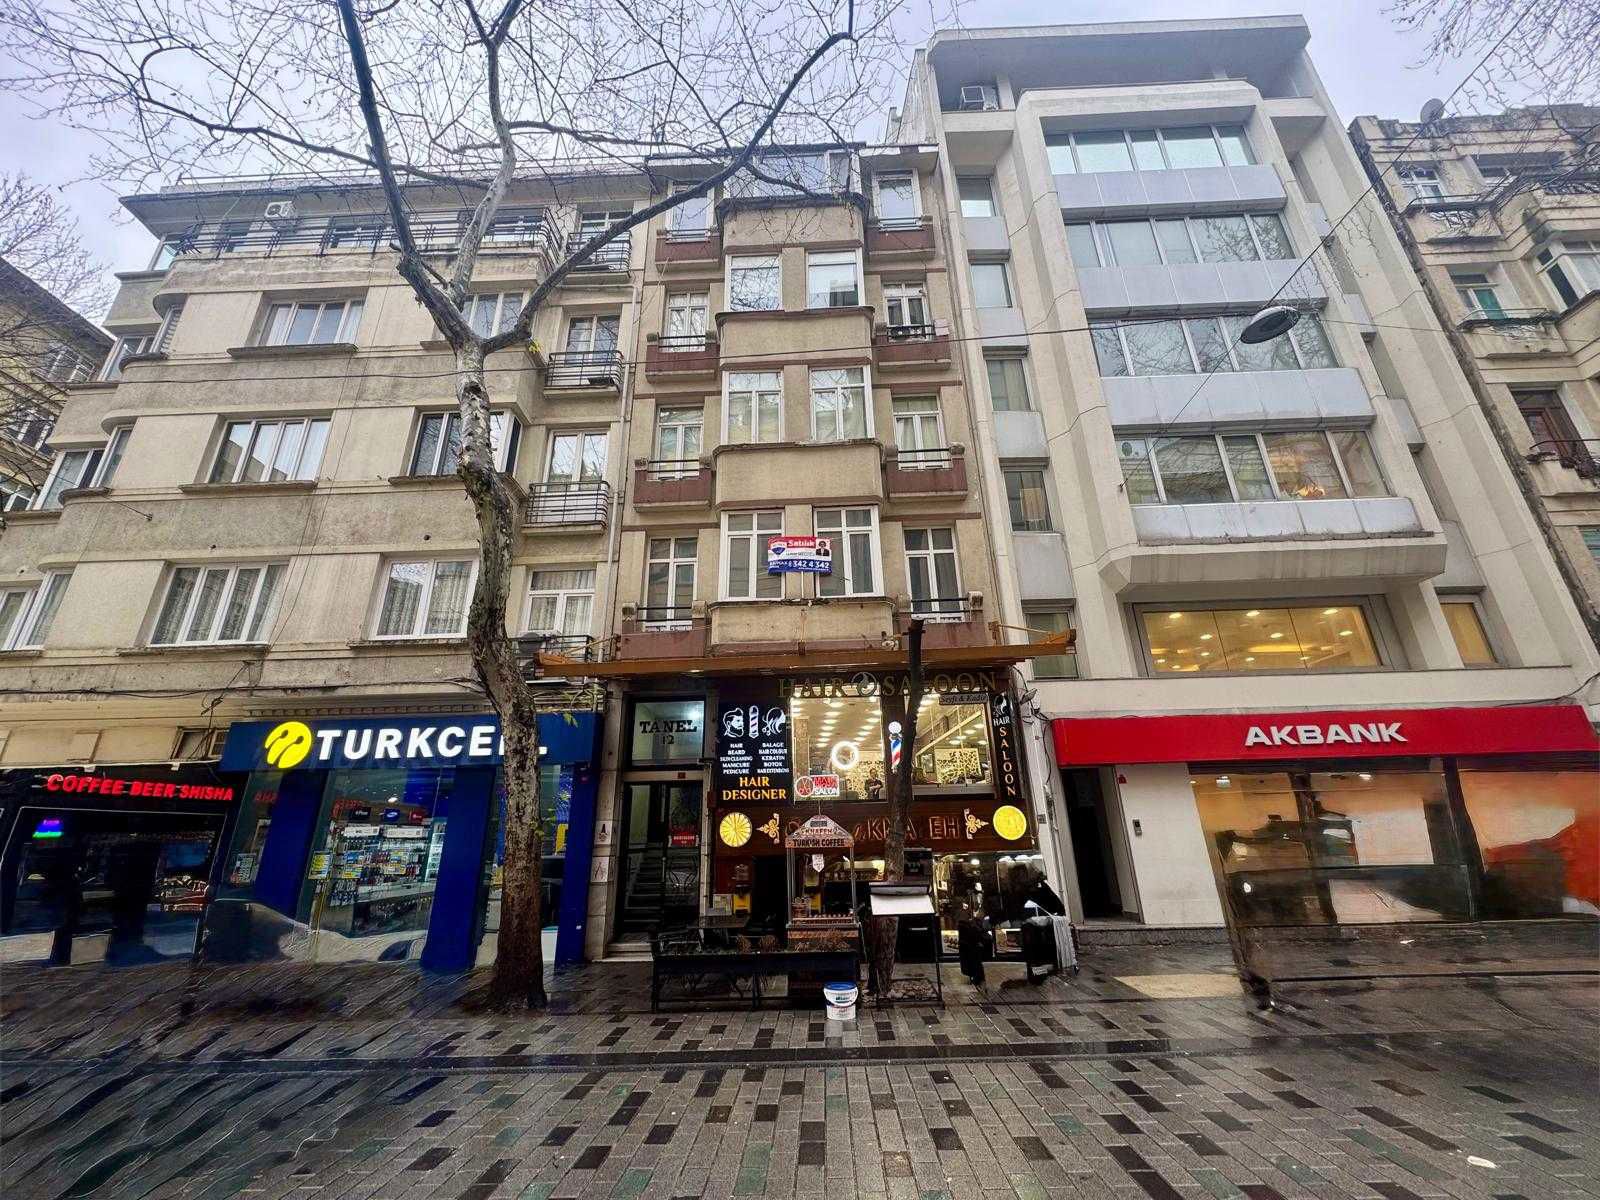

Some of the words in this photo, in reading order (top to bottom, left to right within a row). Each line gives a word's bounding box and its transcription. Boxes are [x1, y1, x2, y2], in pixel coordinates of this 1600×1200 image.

[778, 678, 844, 698] HAIR
[882, 671, 996, 696] SAOON
[640, 720, 697, 733] TANEL
[993, 716, 1010, 726] HAIR
[662, 734, 675, 744] 12
[1245, 722, 1408, 746] AKBANK
[315, 724, 548, 760] TURKCE
[1000, 726, 1016, 796] SALOON
[47, 774, 124, 796] COFFEE
[129, 779, 174, 797] BEER
[179, 784, 233, 801] SHISHA
[739, 776, 770, 787] HAIR
[722, 788, 787, 801] DESIGNER
[793, 839, 820, 847] TURKISH
[821, 839, 845, 847] COFFEE
